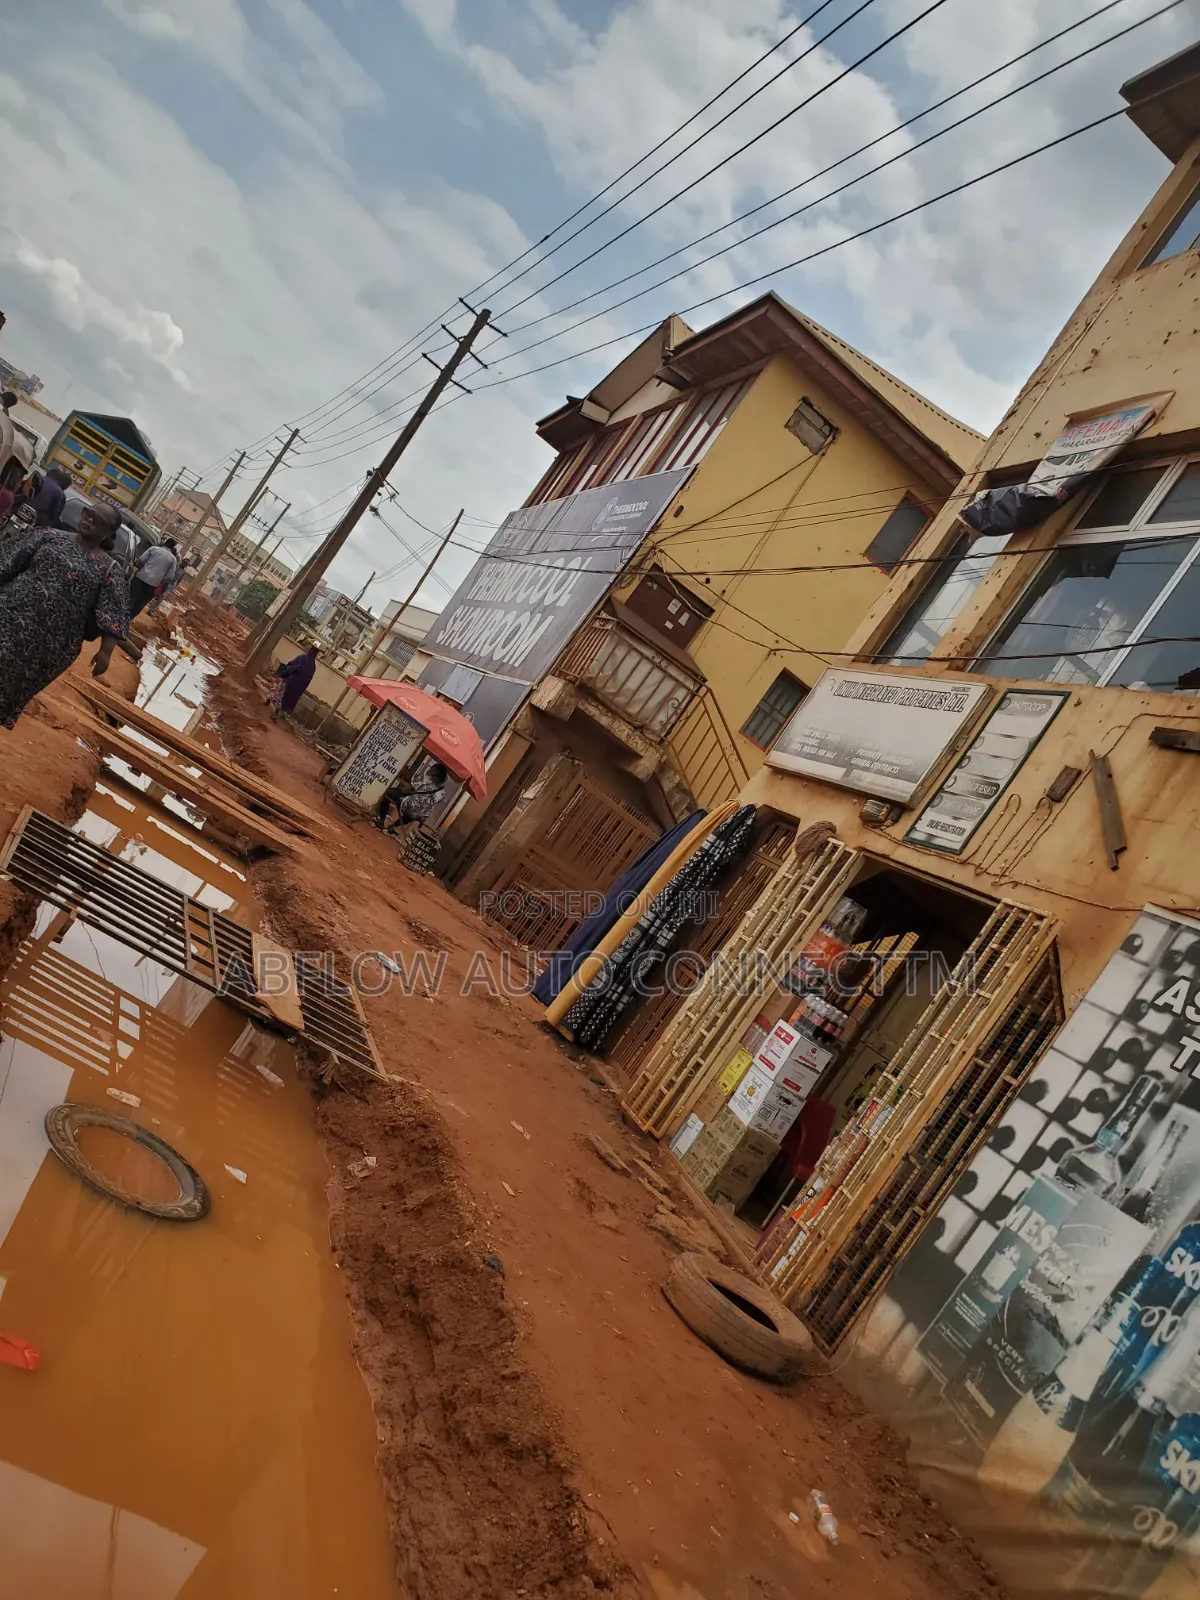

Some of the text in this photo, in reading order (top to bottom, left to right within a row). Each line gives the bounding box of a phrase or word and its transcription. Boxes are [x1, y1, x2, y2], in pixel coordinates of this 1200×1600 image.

[467, 556, 593, 607] THERMOCOOL
[436, 604, 555, 668] SHOWROOM
[854, 682, 899, 704] INTEGRATED
[893, 687, 949, 712] PROPERTIES
[364, 740, 380, 755] CELE
[369, 733, 394, 753] OSHODI
[986, 1337, 1026, 1384] SPECIAL
[1001, 1338, 1024, 1363] VERY
